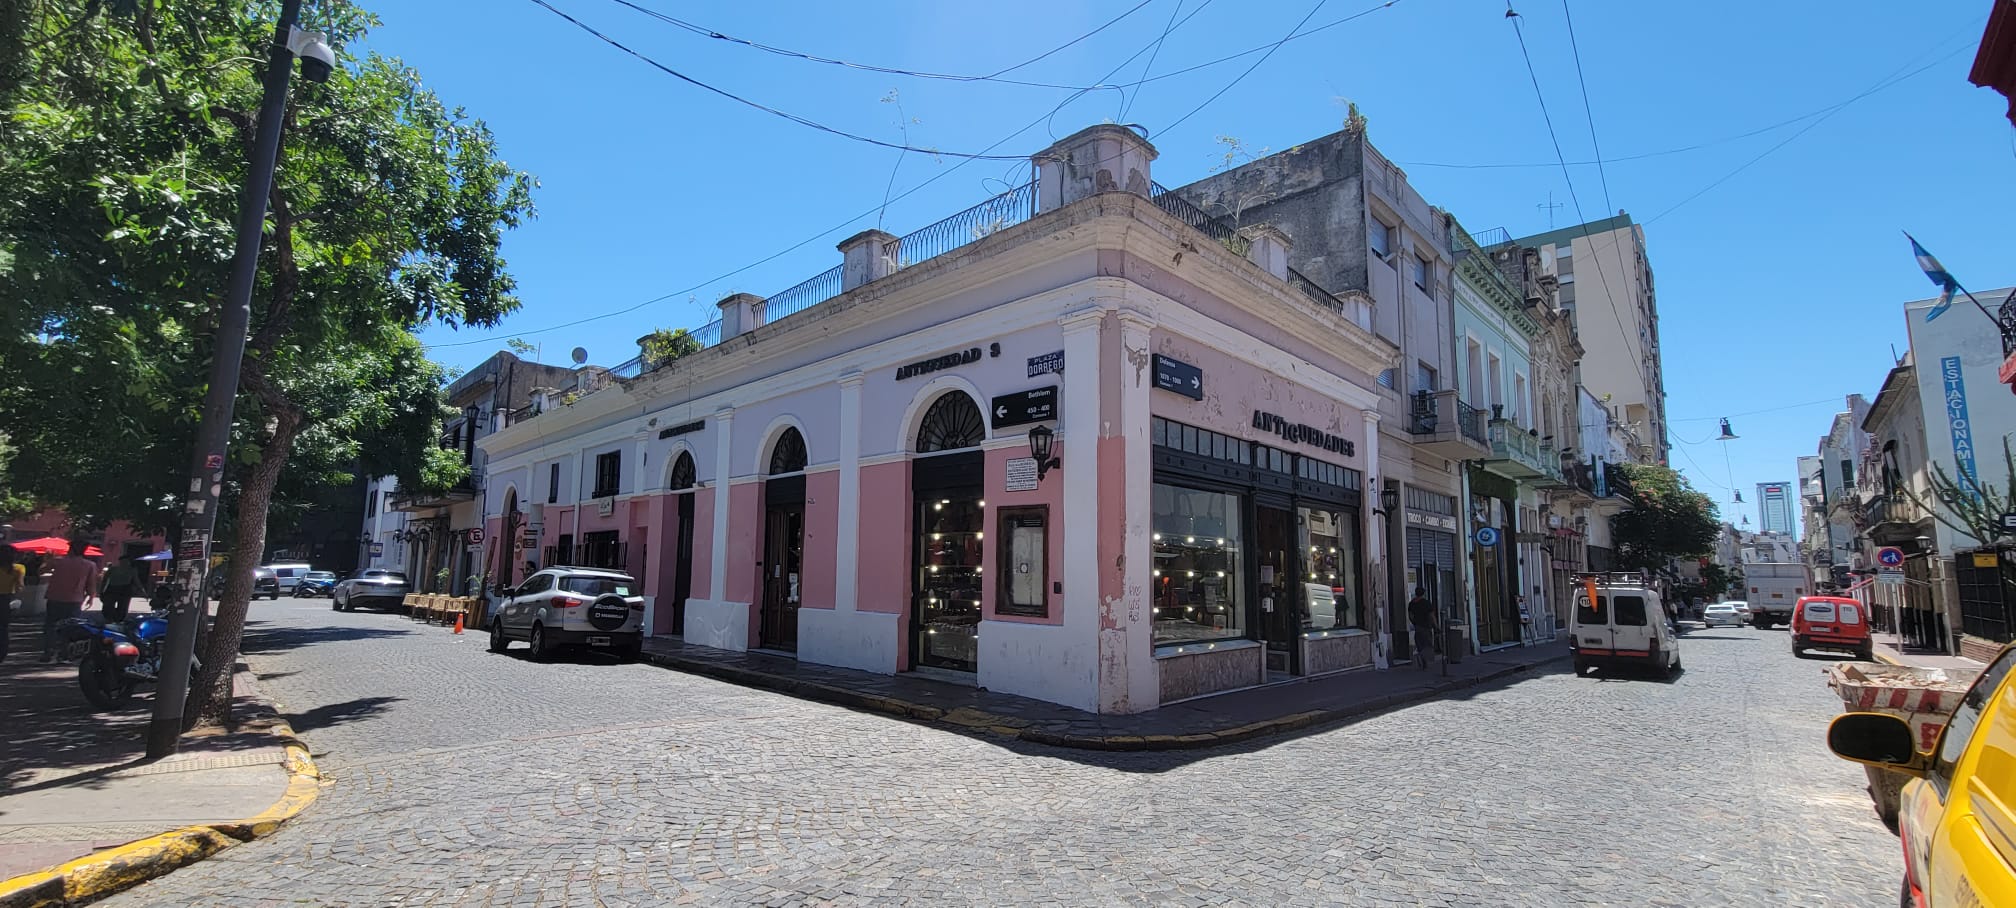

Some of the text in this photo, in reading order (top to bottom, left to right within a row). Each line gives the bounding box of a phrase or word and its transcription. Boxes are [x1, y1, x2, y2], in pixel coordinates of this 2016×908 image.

[1034, 354, 1057, 363] PLAZA
[1028, 358, 1064, 376] DORREGO
[1027, 406, 1037, 414] 450
